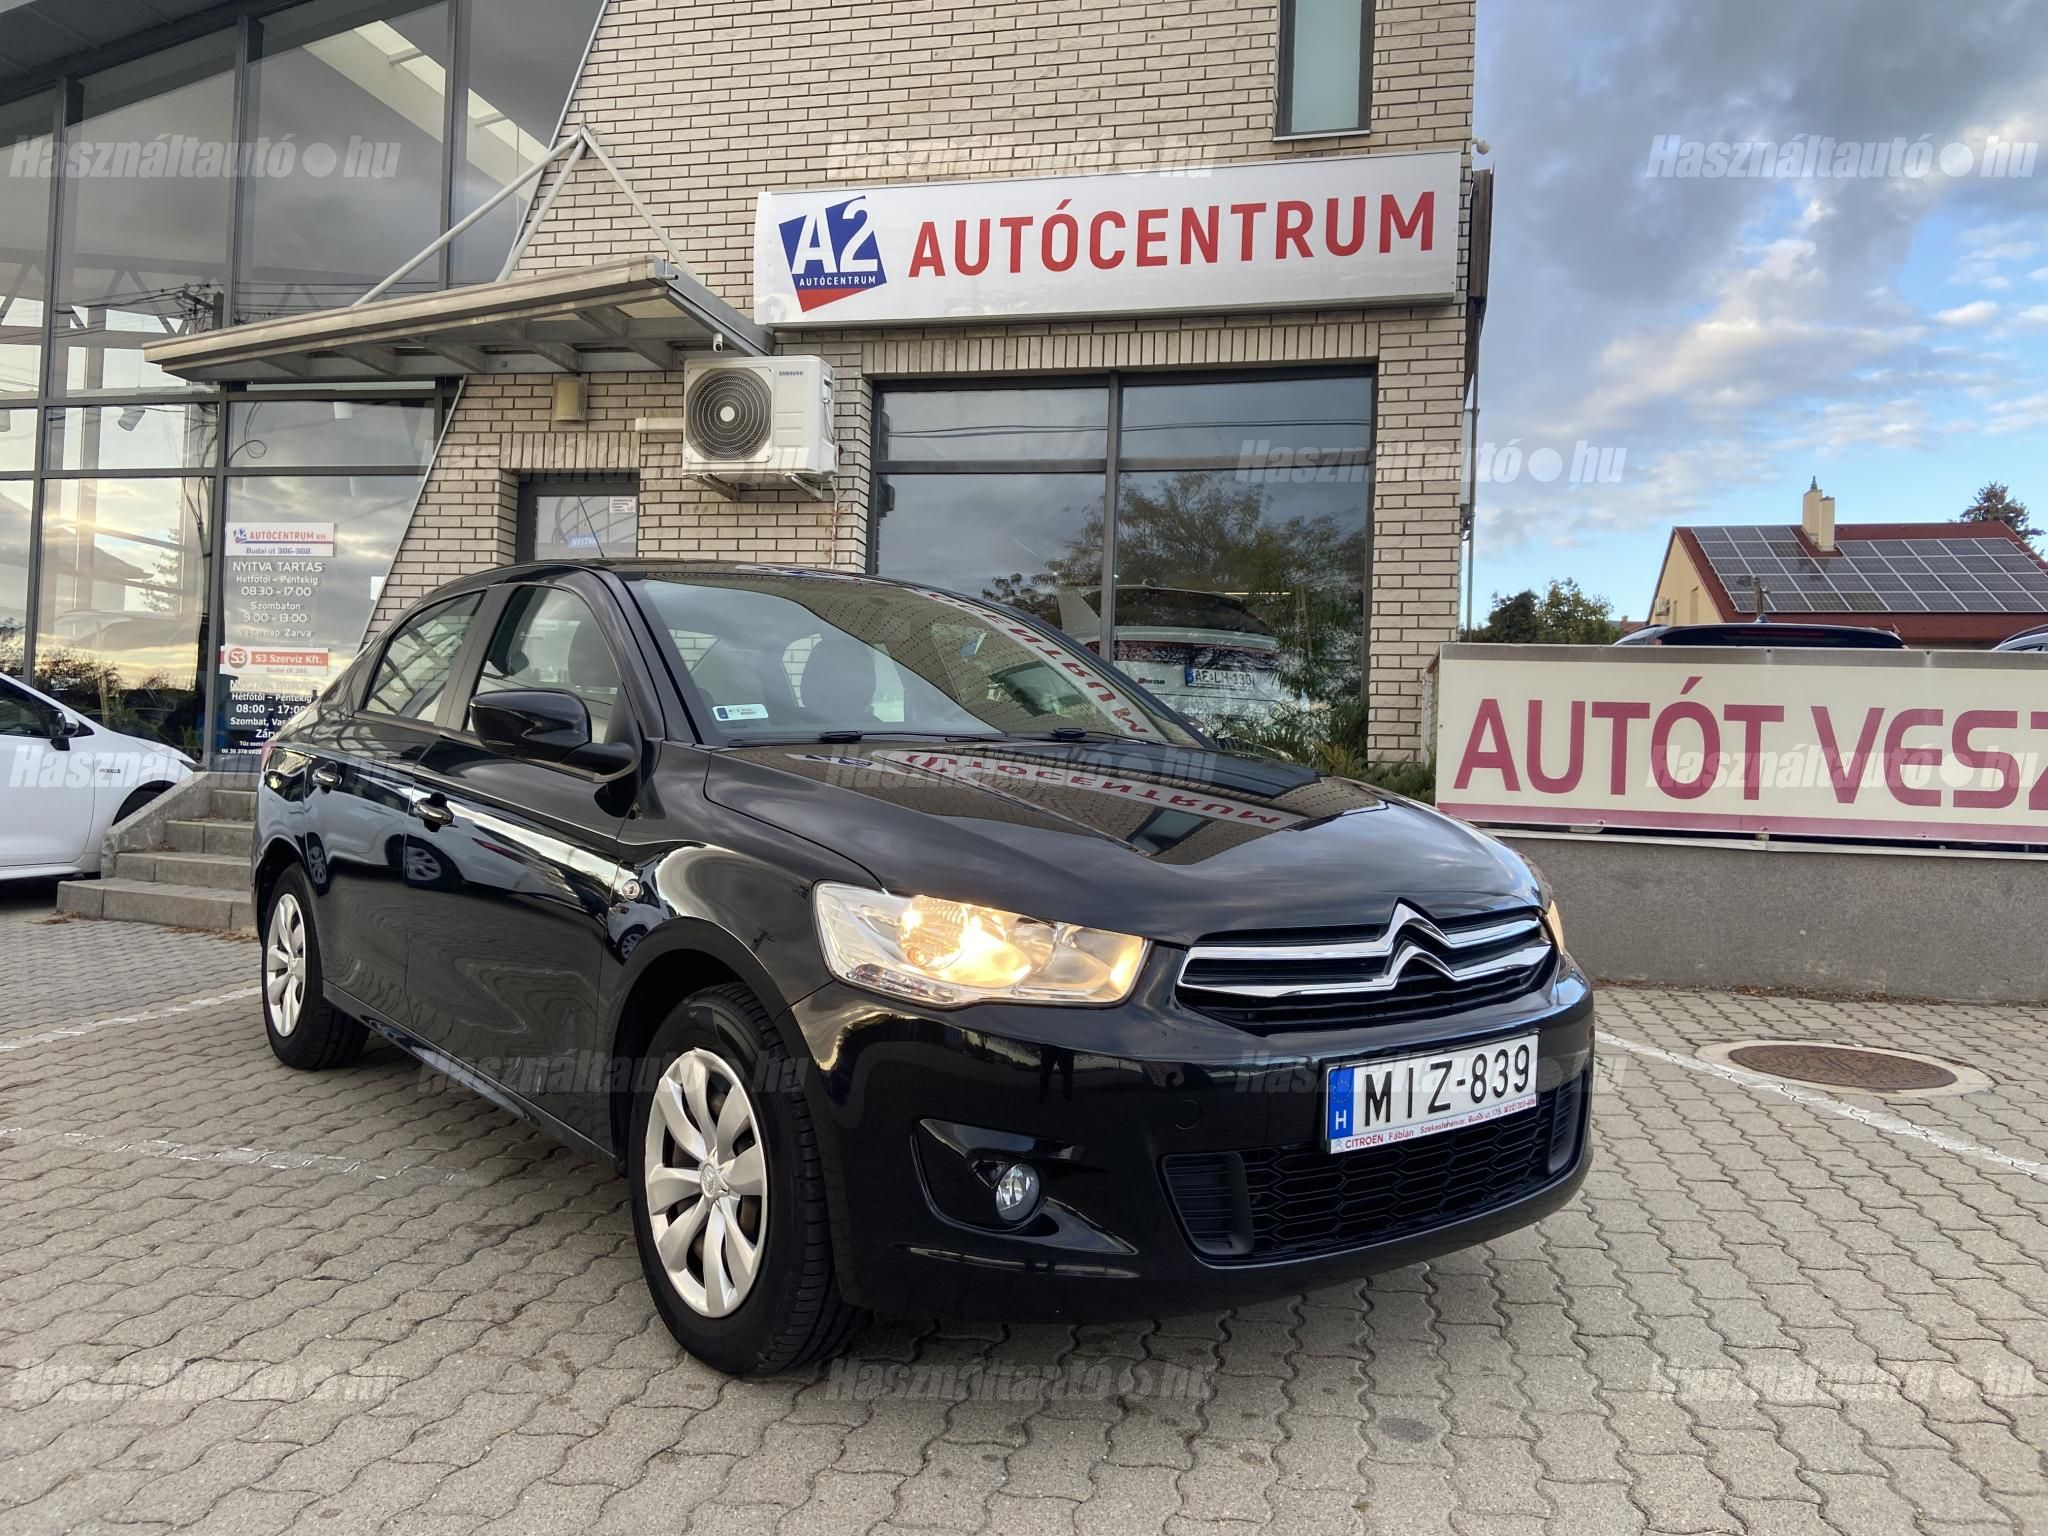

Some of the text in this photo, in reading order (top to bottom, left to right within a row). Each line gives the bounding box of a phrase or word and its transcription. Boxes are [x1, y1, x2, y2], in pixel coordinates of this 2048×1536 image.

[792, 198, 878, 274] A2
[908, 190, 1436, 278] AUTÓCENTRUM
[799, 274, 876, 287] AUTÓCENTRUM
[232, 559, 323, 572] NYITVA TARTÁS
[250, 601, 301, 611] Szombaton
[230, 651, 246, 664] S3
[255, 654, 323, 664] S3 Szerviz Kft.
[236, 704, 265, 714] 08:00
[230, 716, 270, 727] Szombat,
[1453, 676, 2048, 811] AUTÓT VES
[1364, 1044, 1530, 1127] MIZ-839
[1335, 1109, 1347, 1130] H
